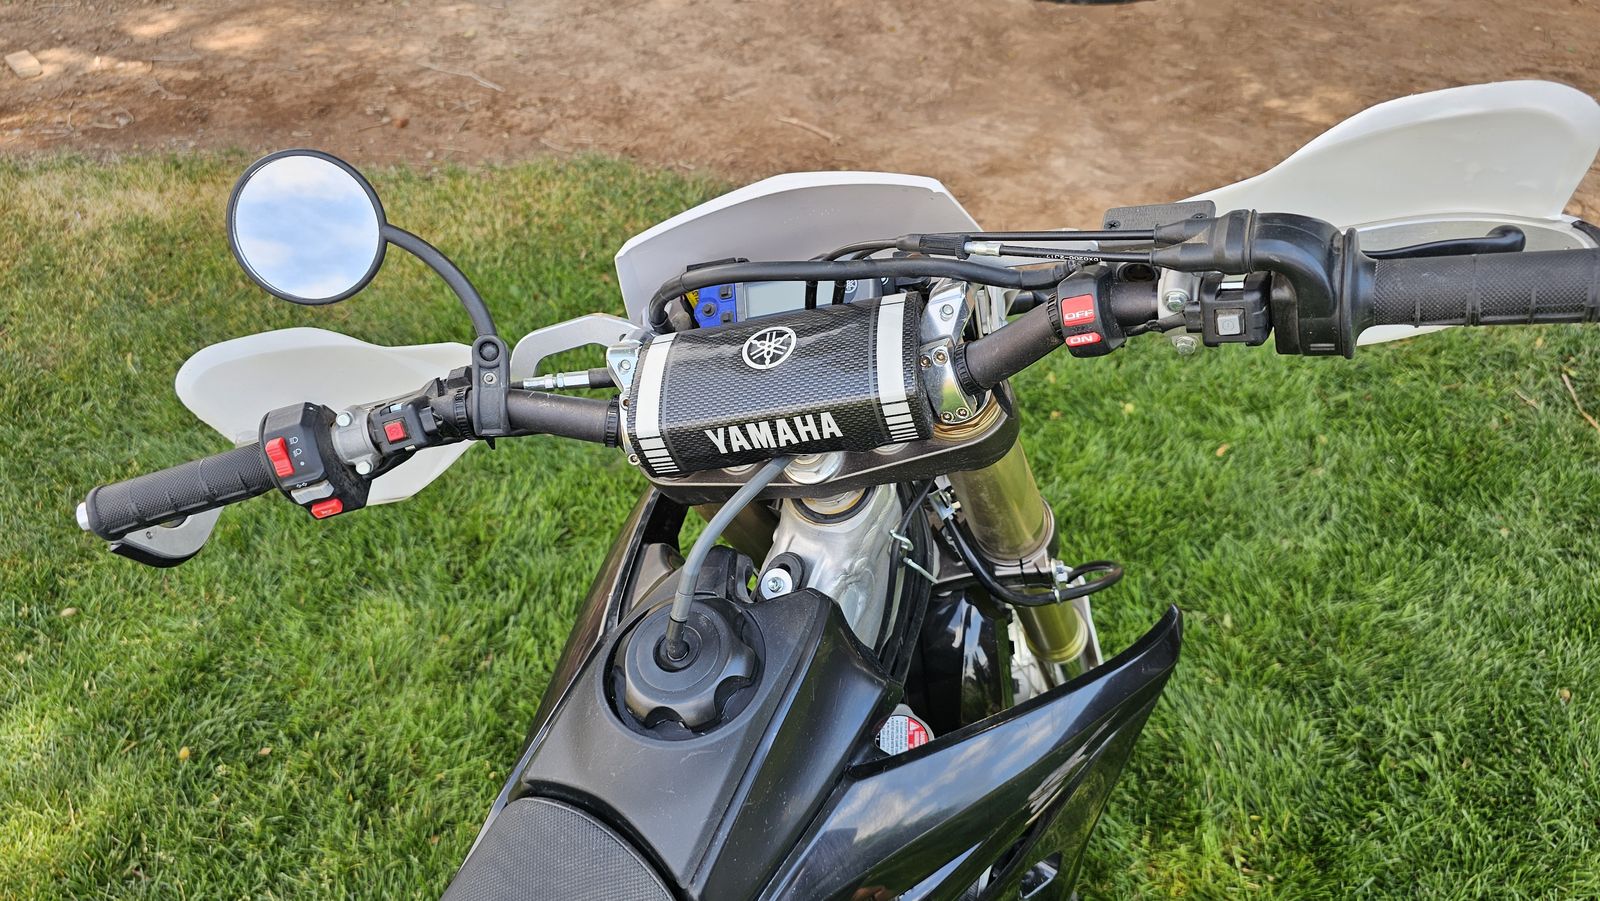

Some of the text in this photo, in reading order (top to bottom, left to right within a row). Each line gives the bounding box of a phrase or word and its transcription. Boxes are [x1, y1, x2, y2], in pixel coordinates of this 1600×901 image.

[1065, 309, 1093, 320] OFF
[1070, 335, 1093, 344] ON
[704, 411, 844, 454] YAMAHA
